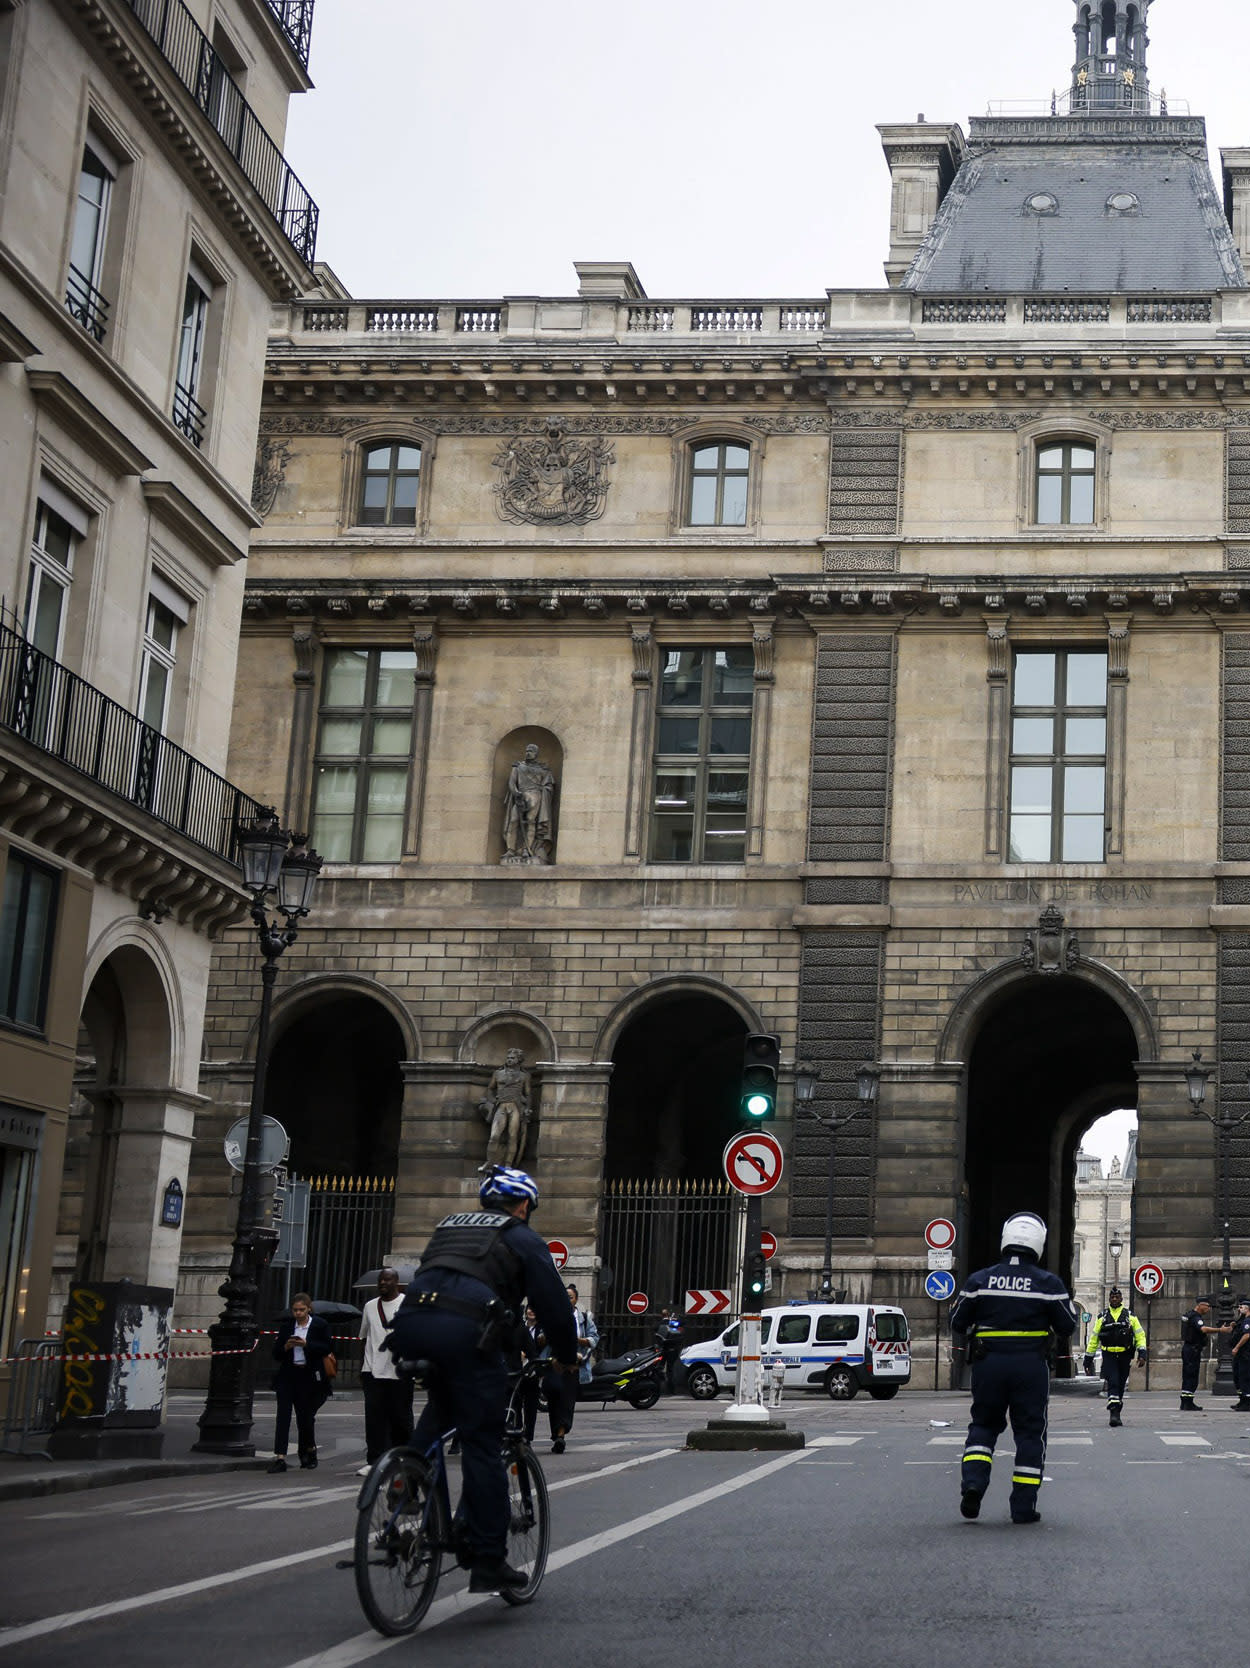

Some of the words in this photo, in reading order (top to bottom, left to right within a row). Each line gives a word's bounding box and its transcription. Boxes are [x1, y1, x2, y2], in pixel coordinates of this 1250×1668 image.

[954, 884, 1040, 901] PAVILLON
[1052, 884, 1075, 901] DE
[1089, 883, 1153, 900] ROHAN
[442, 1214, 503, 1226] POLICE
[988, 1276, 1032, 1291] POLICE
[1141, 1272, 1156, 1285] 15
